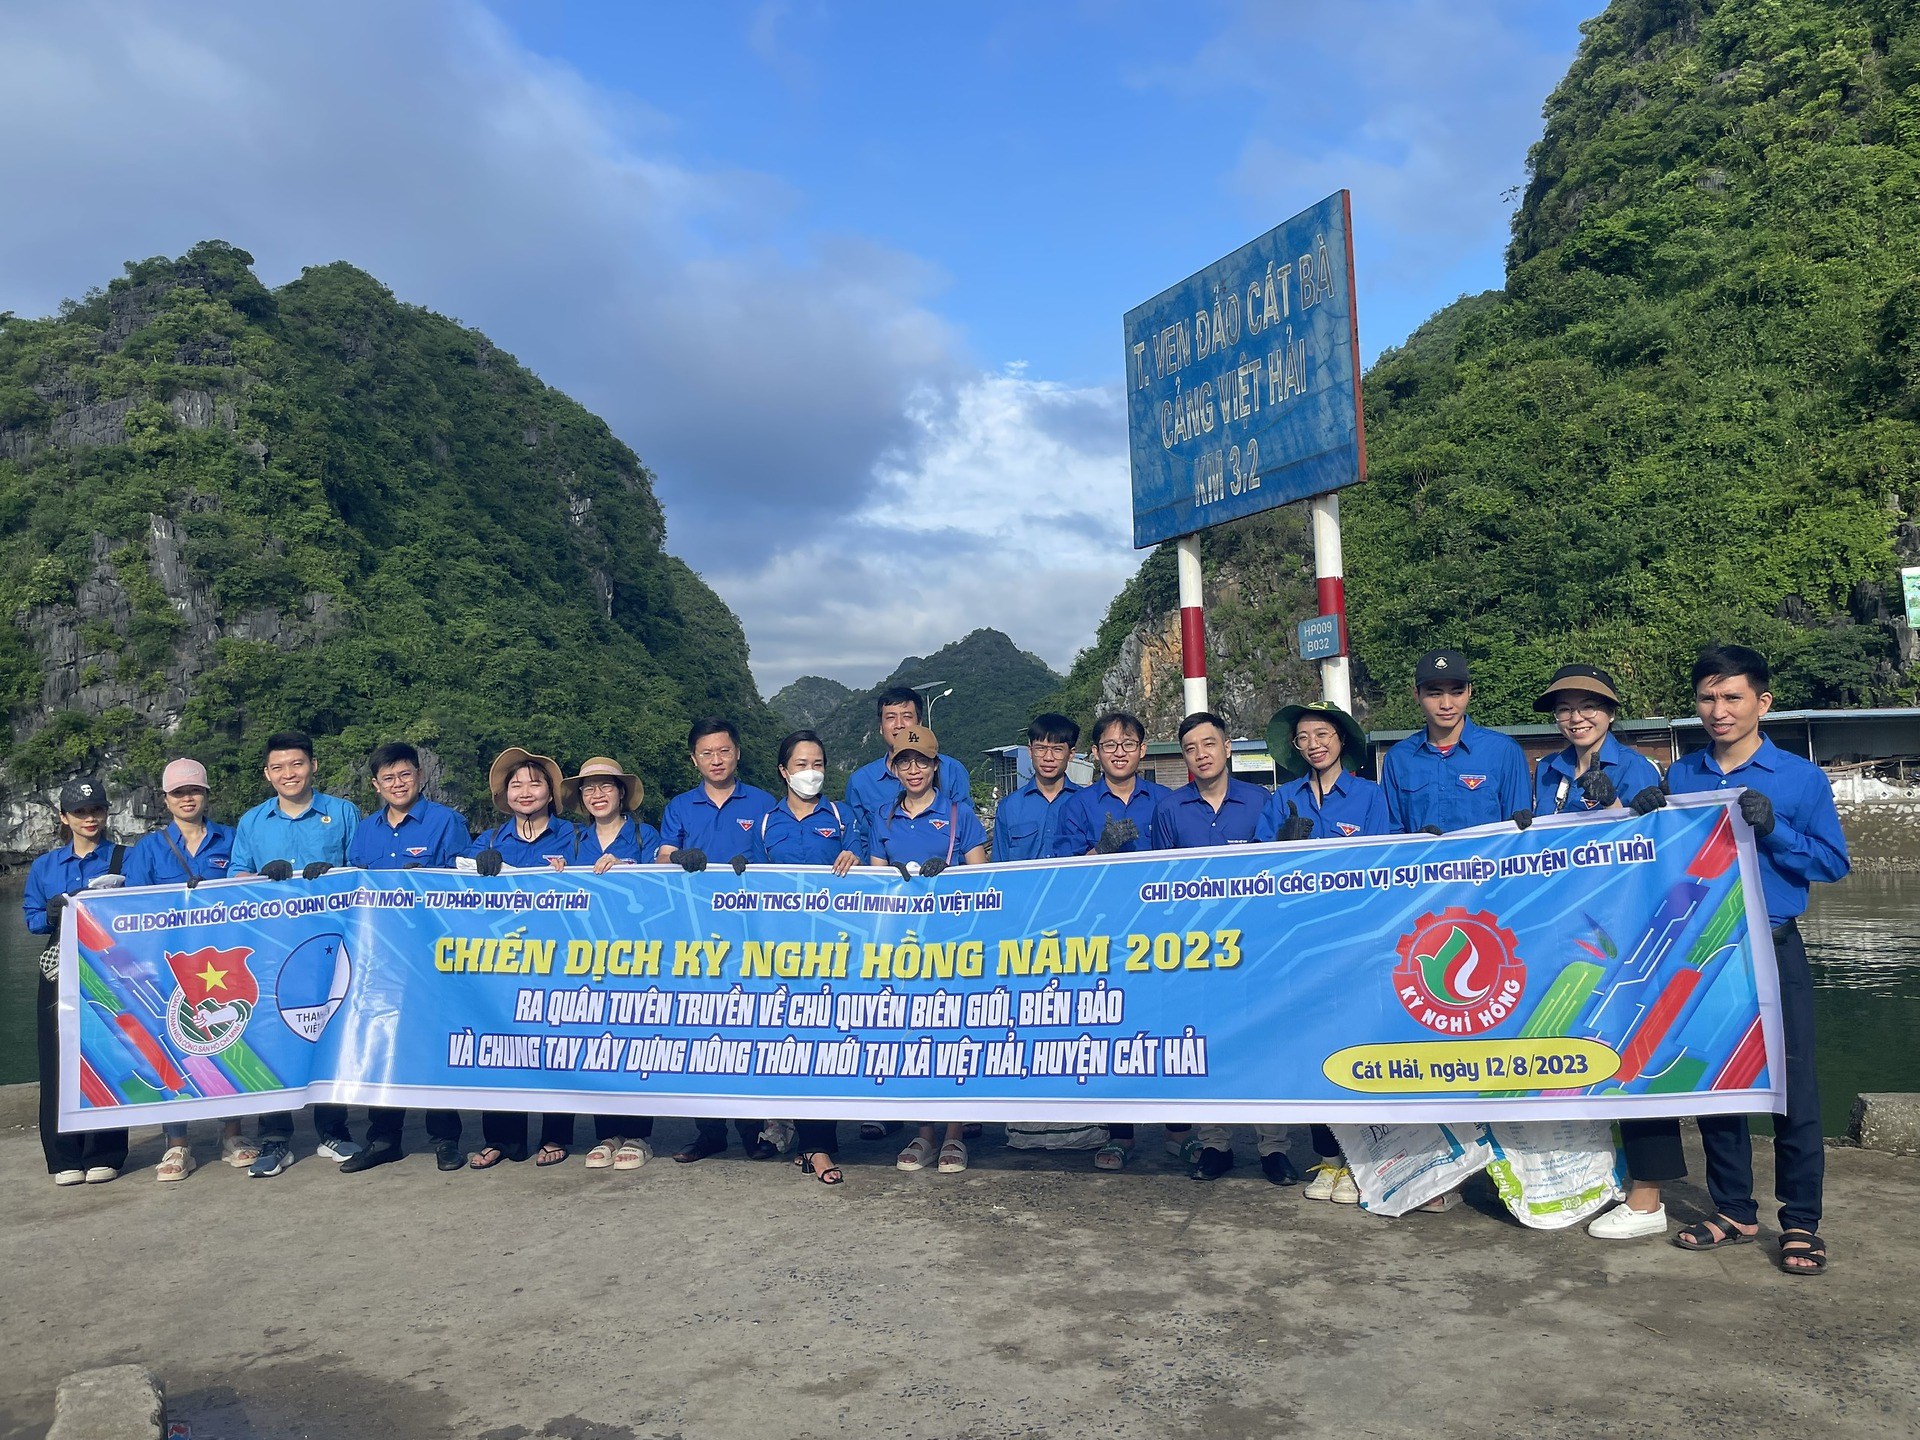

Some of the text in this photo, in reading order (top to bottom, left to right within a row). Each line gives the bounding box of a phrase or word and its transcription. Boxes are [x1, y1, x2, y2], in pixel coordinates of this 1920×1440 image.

[1133, 233, 1335, 390] T. VEN ĐẢO CÁT BÀ
[1161, 323, 1307, 450] CẢNG VIỆT HẢI
[1194, 449, 1225, 508] KM
[1304, 621, 1333, 637] HP009
[1307, 637, 1330, 653] B032
[1141, 834, 1656, 901] CHI ĐOÀN KHỐI CÁC ĐƠN VỊ SỰ NGHIỆP HUYỆN CÁT HẢI
[113, 914, 139, 932] CHI
[142, 908, 187, 930] ĐOÀN
[190, 902, 226, 925] KHỐI
[230, 899, 257, 920] CÁC
[286, 896, 326, 917] QUAN
[328, 888, 375, 911] CHUYÊN
[378, 888, 415, 908] MÔN
[446, 888, 483, 909] PHÁP
[485, 890, 532, 913] HUYỆN
[535, 890, 564, 910] CÁT
[565, 888, 590, 909] HẢI
[713, 888, 1002, 915] ĐOÀN TNCS HỒ CHÍ MINH XÃ VIỆT HẢI
[434, 926, 1242, 982] CHIẾN DỊCH KỲ NGHỈ HỒNG NĂM 2023
[514, 979, 1124, 1031] RA QUÂN TUYÊN TRUYỀN VỀ CHỦ QUYỀN BIÊN GIỚI, BIỂN ĐẢO
[1400, 979, 1521, 1032] KỲ NGHỈ HỒNG
[449, 1027, 1207, 1084] VÀ CHUNG TAY XÂY DỰNG NÔNG THÔN MỚI TẠI XÃ VIỆT HẢI, HUYỆN CÁT HẢI
[1351, 1053, 1589, 1083] Cát Hải, ngày 12/8/2023
